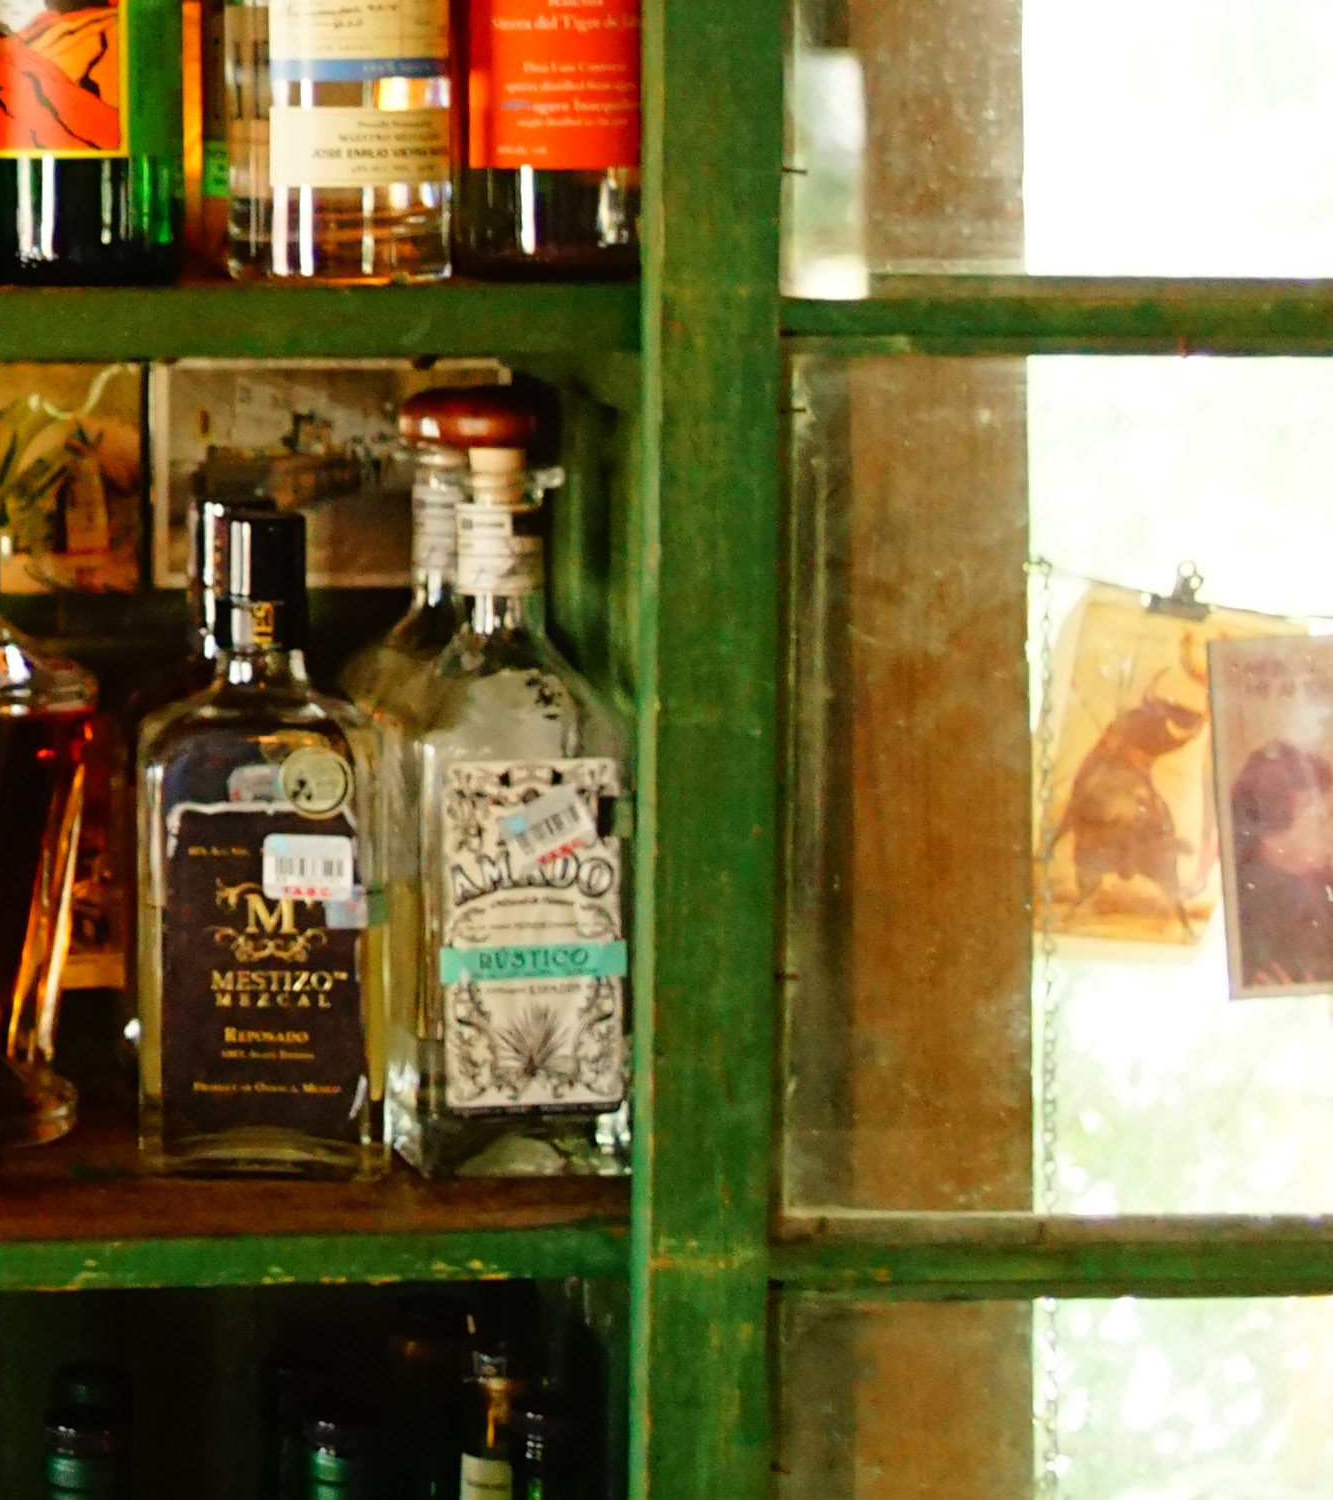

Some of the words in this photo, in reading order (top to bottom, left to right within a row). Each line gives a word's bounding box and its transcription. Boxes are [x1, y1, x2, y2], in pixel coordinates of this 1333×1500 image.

[451, 850, 614, 906] AMDO
[246, 894, 298, 934] M
[210, 970, 333, 991] MESTIZO
[215, 993, 332, 1008] MEZCAL
